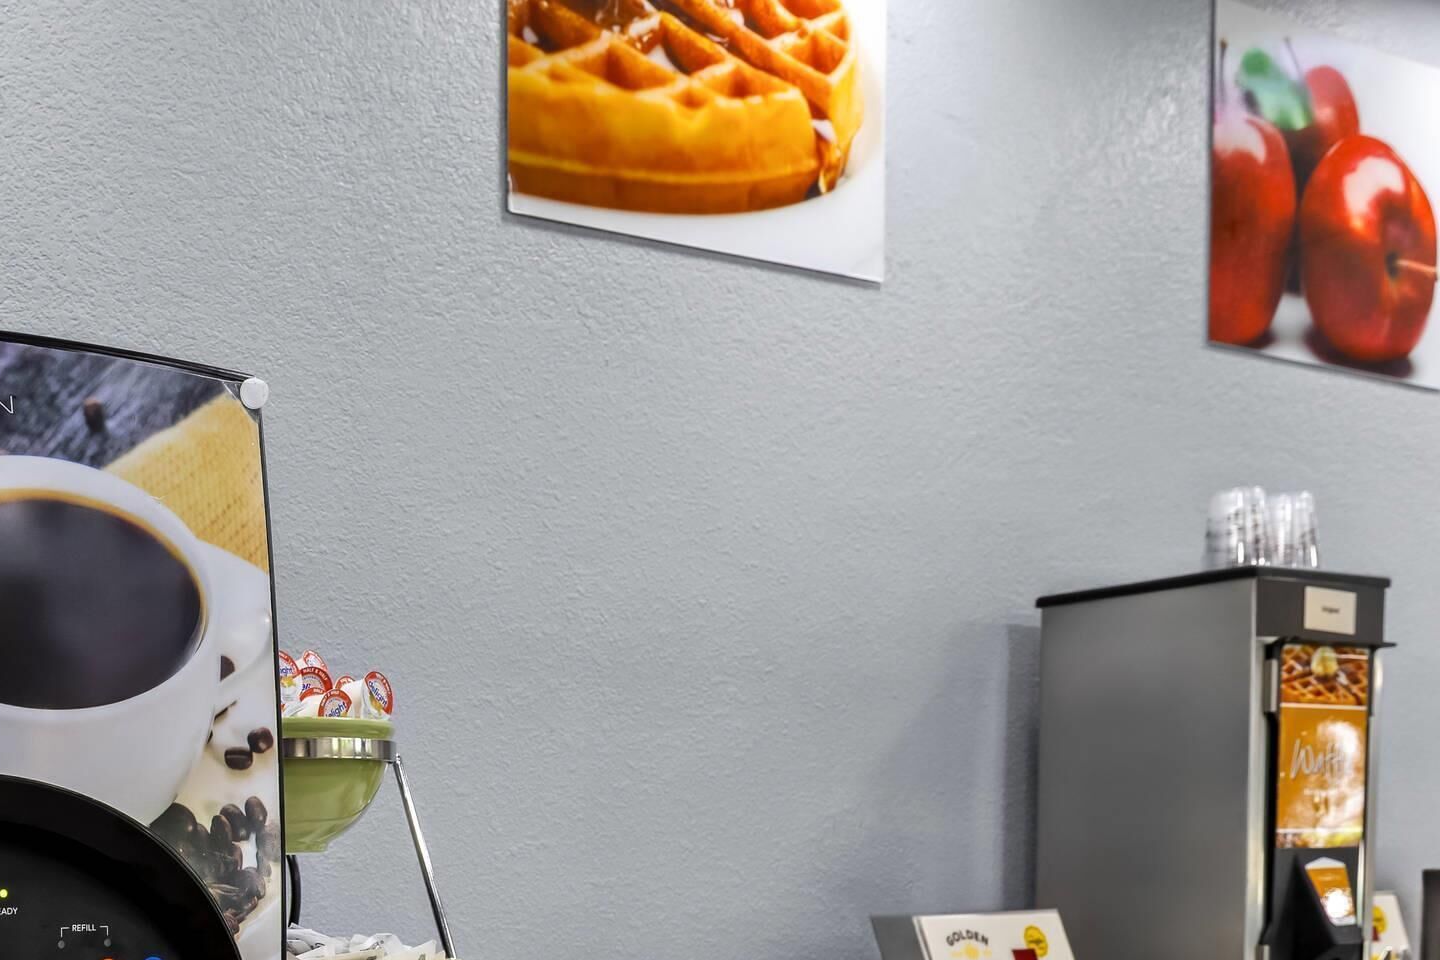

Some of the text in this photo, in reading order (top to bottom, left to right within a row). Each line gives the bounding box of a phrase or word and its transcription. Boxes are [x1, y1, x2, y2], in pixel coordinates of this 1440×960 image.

[368, 681, 388, 706] delight
[326, 701, 347, 717] elight
[71, 924, 97, 932] REFILL
[946, 929, 989, 946] GOLDEN
